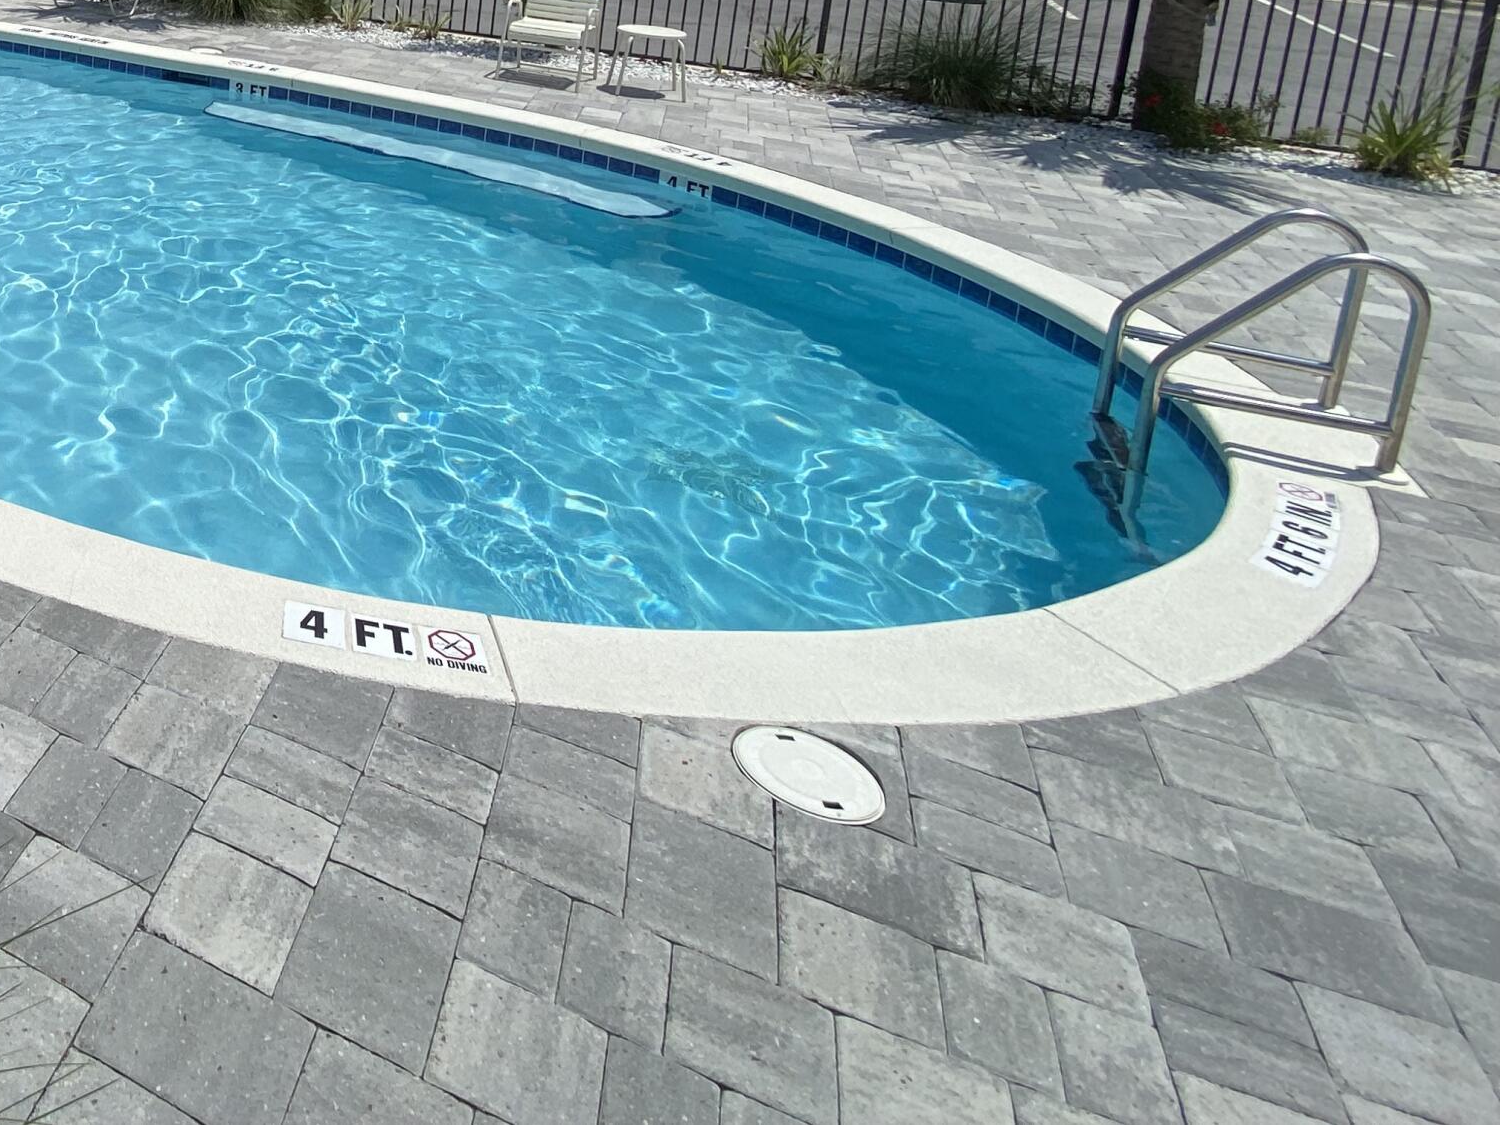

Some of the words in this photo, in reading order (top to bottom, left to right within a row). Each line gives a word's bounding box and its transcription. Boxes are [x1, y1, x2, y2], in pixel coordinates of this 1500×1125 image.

[250, 84, 267, 96] FT
[686, 181, 710, 197] FT
[1282, 520, 1329, 540] 6
[1265, 555, 1314, 576] 4
[300, 610, 328, 639] 4
[355, 618, 413, 656] FT.
[427, 657, 444, 667] NO
[447, 660, 488, 674] DIVING
